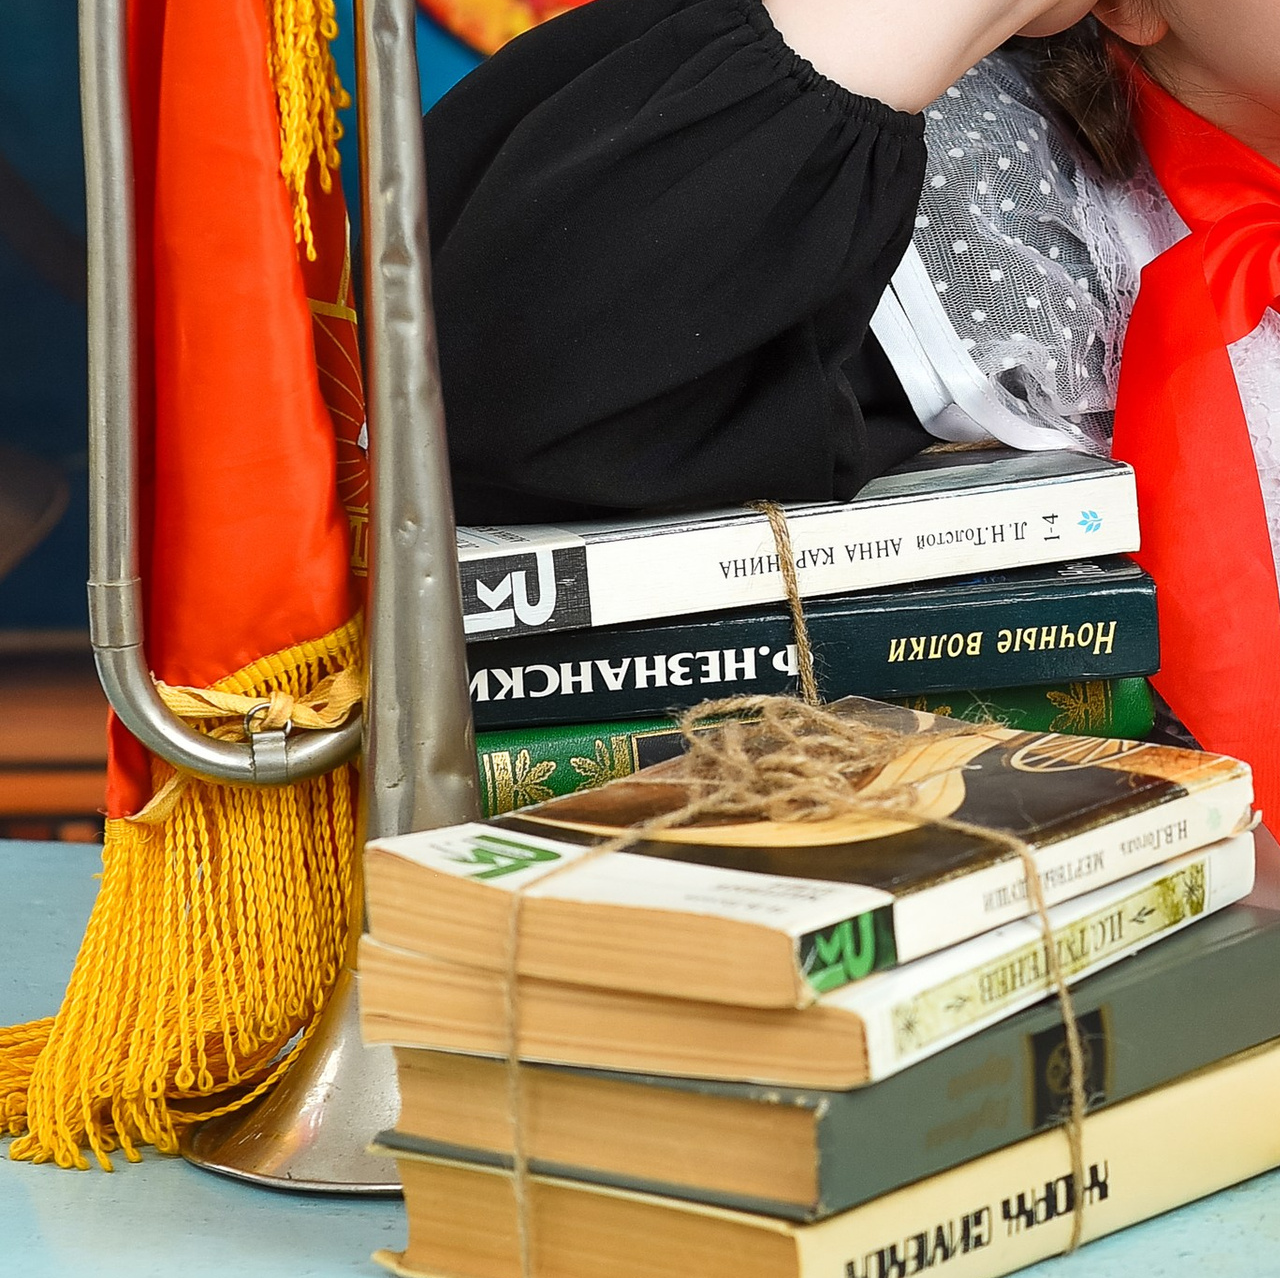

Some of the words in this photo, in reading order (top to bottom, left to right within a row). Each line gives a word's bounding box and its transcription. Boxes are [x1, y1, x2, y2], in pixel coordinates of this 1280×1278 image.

[719, 546, 835, 579] КАРНИНА
[844, 534, 904, 564] АННА
[887, 631, 983, 663] волки
[997, 620, 1118, 656] Ночные
[1036, 850, 1105, 894] МЕРТВЫ
